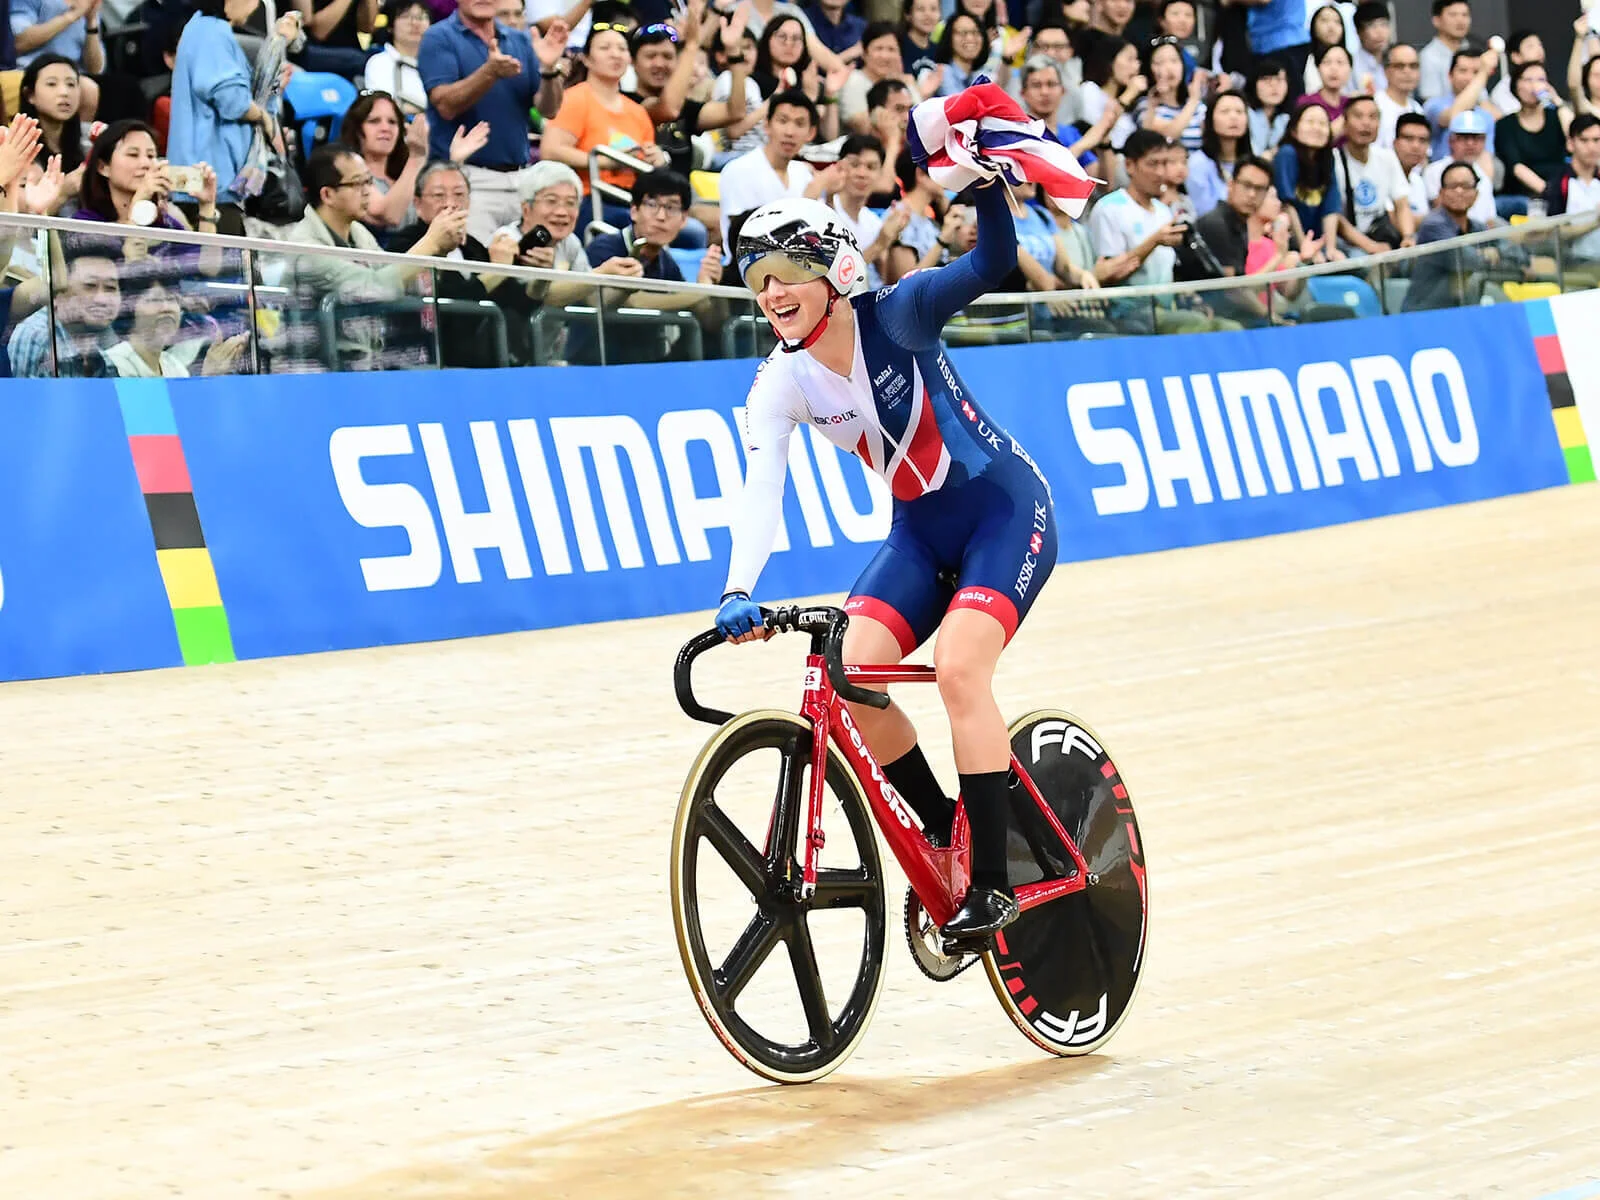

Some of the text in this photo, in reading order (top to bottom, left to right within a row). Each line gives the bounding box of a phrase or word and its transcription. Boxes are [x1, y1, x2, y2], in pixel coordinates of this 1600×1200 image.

[842, 410, 858, 421] UK
[936, 351, 1005, 451] HSBC UK
[1066, 347, 1480, 516] SHIMANO
[1014, 500, 1047, 600] HSBC UK
